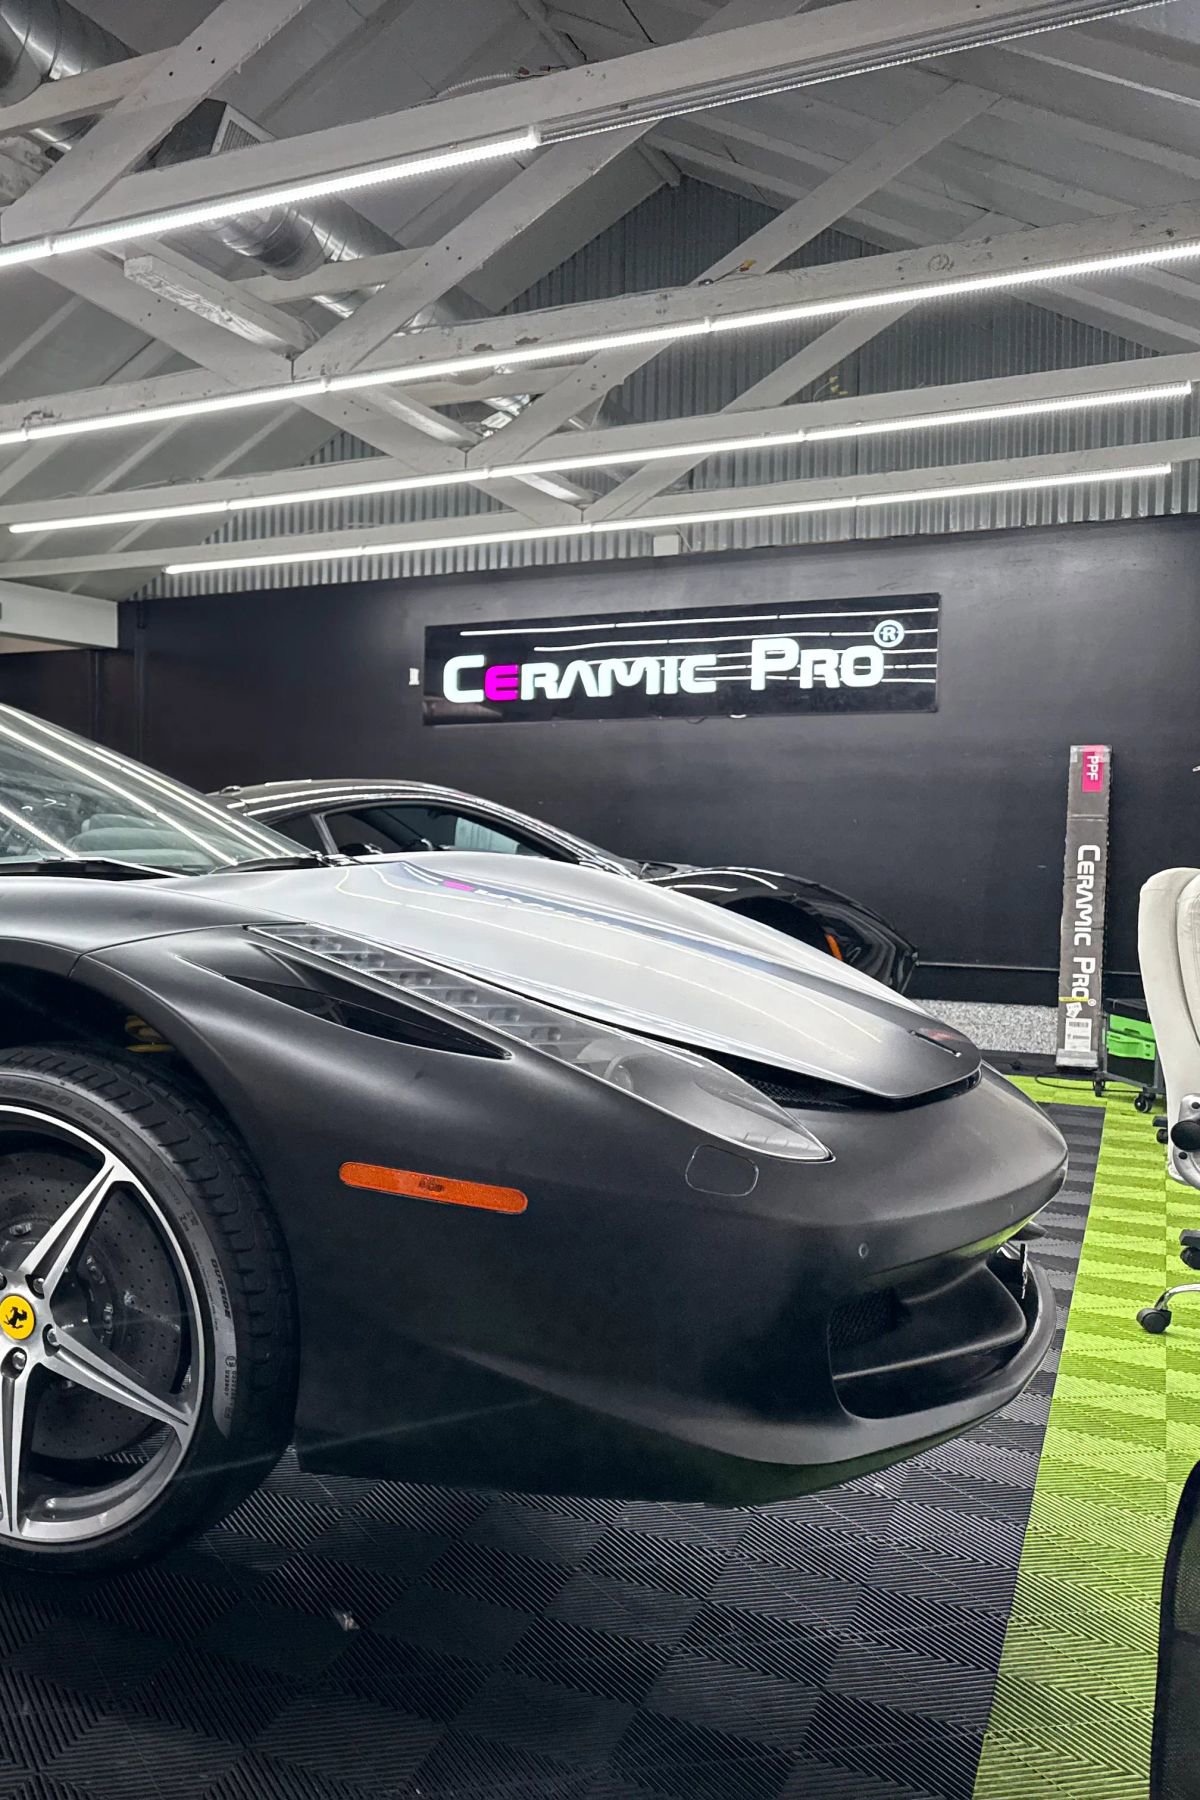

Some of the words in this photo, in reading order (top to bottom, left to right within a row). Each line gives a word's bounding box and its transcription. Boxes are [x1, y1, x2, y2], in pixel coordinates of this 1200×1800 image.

[442, 653, 718, 704] CERAMIC
[1086, 755, 1099, 782] PPF
[1073, 844, 1101, 947] CERAMIC
[211, 1258, 231, 1320] OUTSIDE
